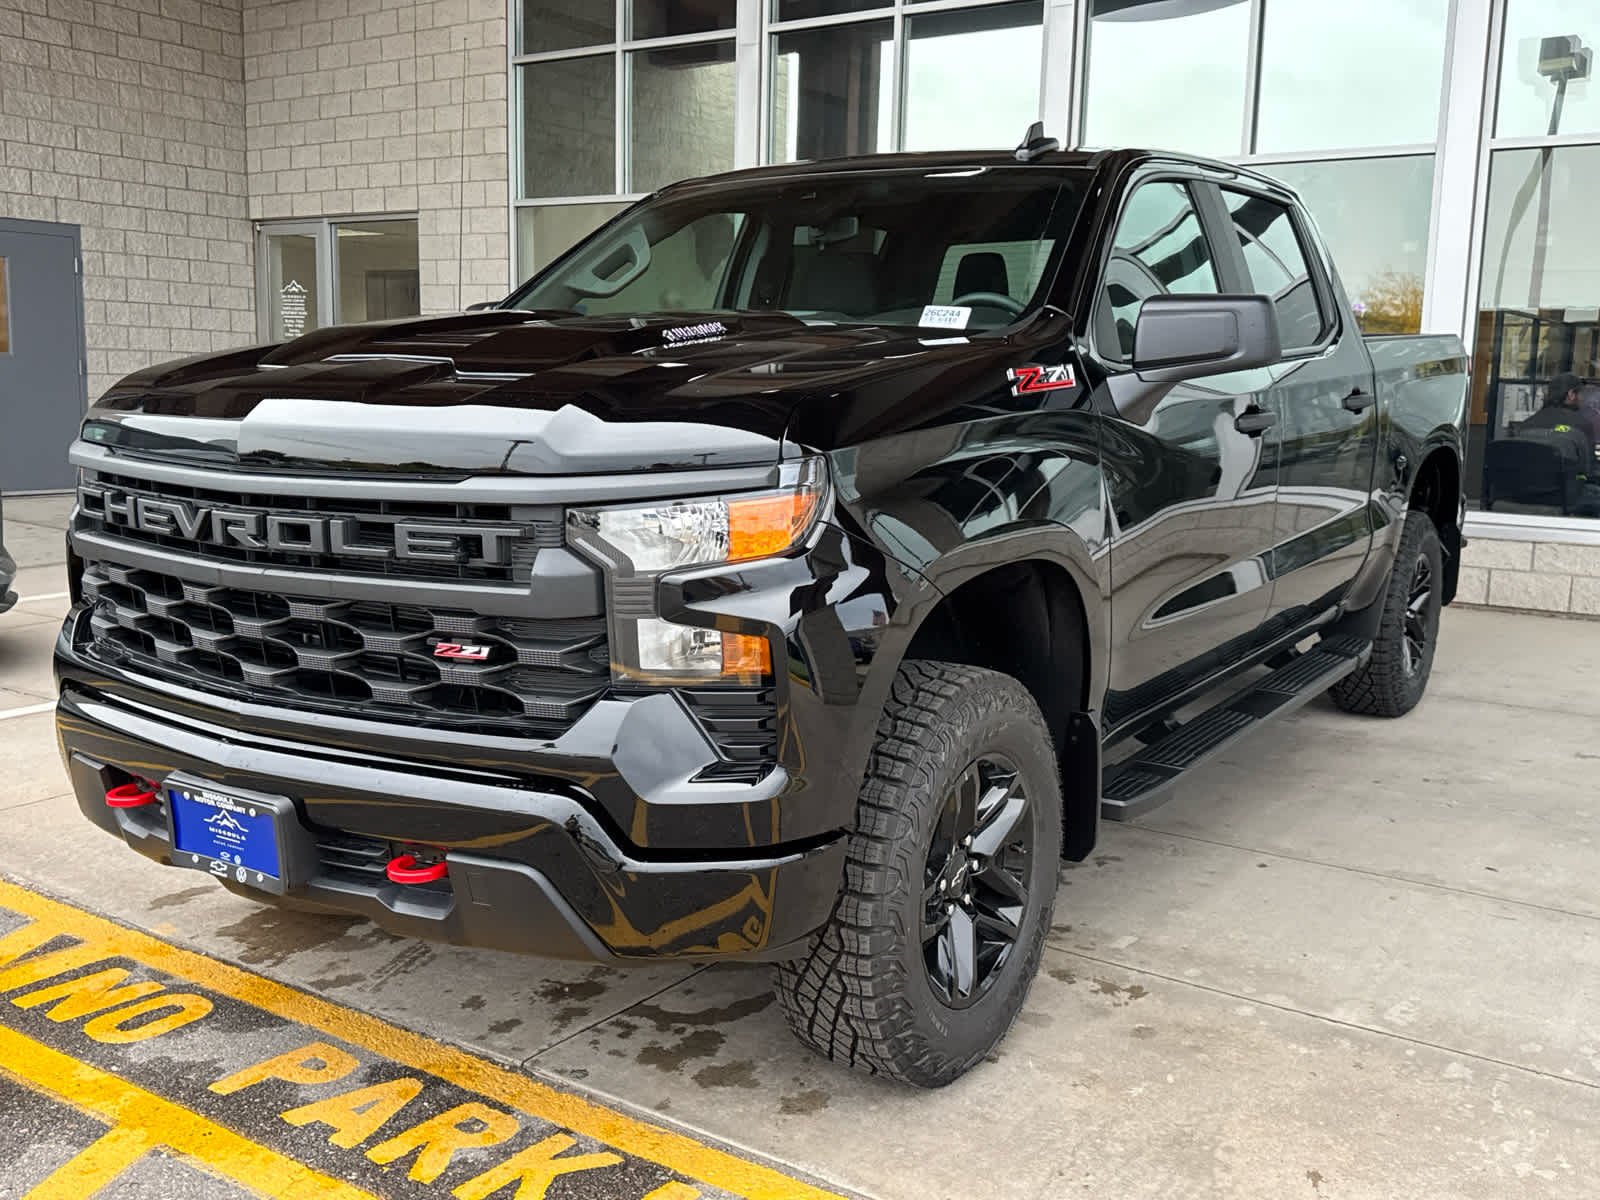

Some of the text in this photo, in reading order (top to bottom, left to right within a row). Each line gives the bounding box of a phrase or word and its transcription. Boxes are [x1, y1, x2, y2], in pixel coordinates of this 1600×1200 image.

[1006, 363, 1076, 397] Z71
[78, 485, 534, 566] CHEVROLET
[433, 641, 490, 660] Z71
[209, 826, 246, 840] MISSOULA
[12, 967, 703, 1200] NO PARK
